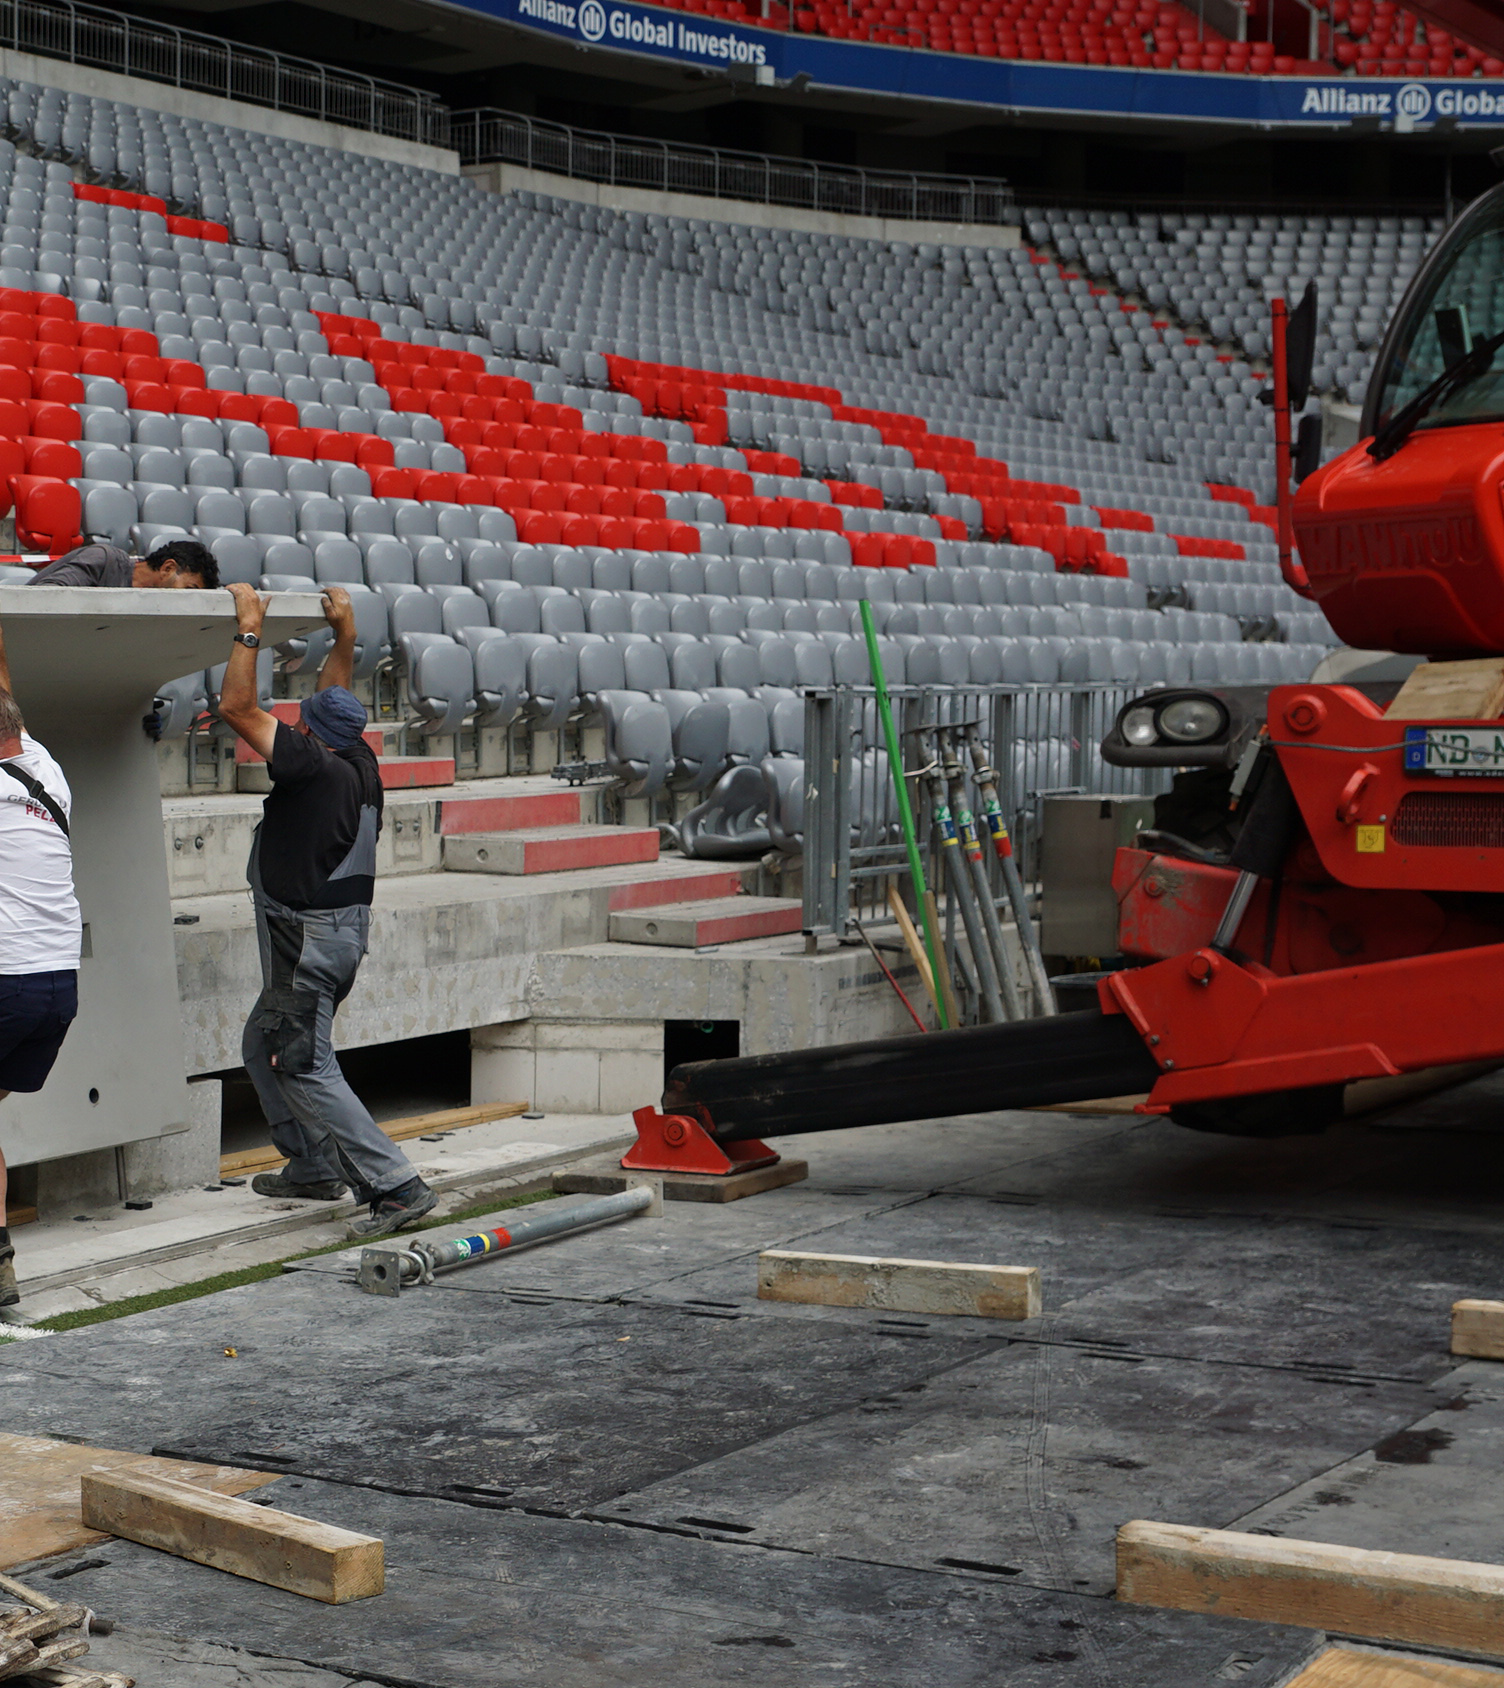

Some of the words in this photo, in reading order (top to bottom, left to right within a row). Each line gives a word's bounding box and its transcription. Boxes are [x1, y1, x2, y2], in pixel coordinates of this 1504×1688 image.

[519, 0, 577, 29] Allianz
[609, 10, 674, 48] Global
[678, 23, 766, 65] Investors
[1302, 86, 1392, 114] Allianz
[1427, 734, 1470, 764] ND
